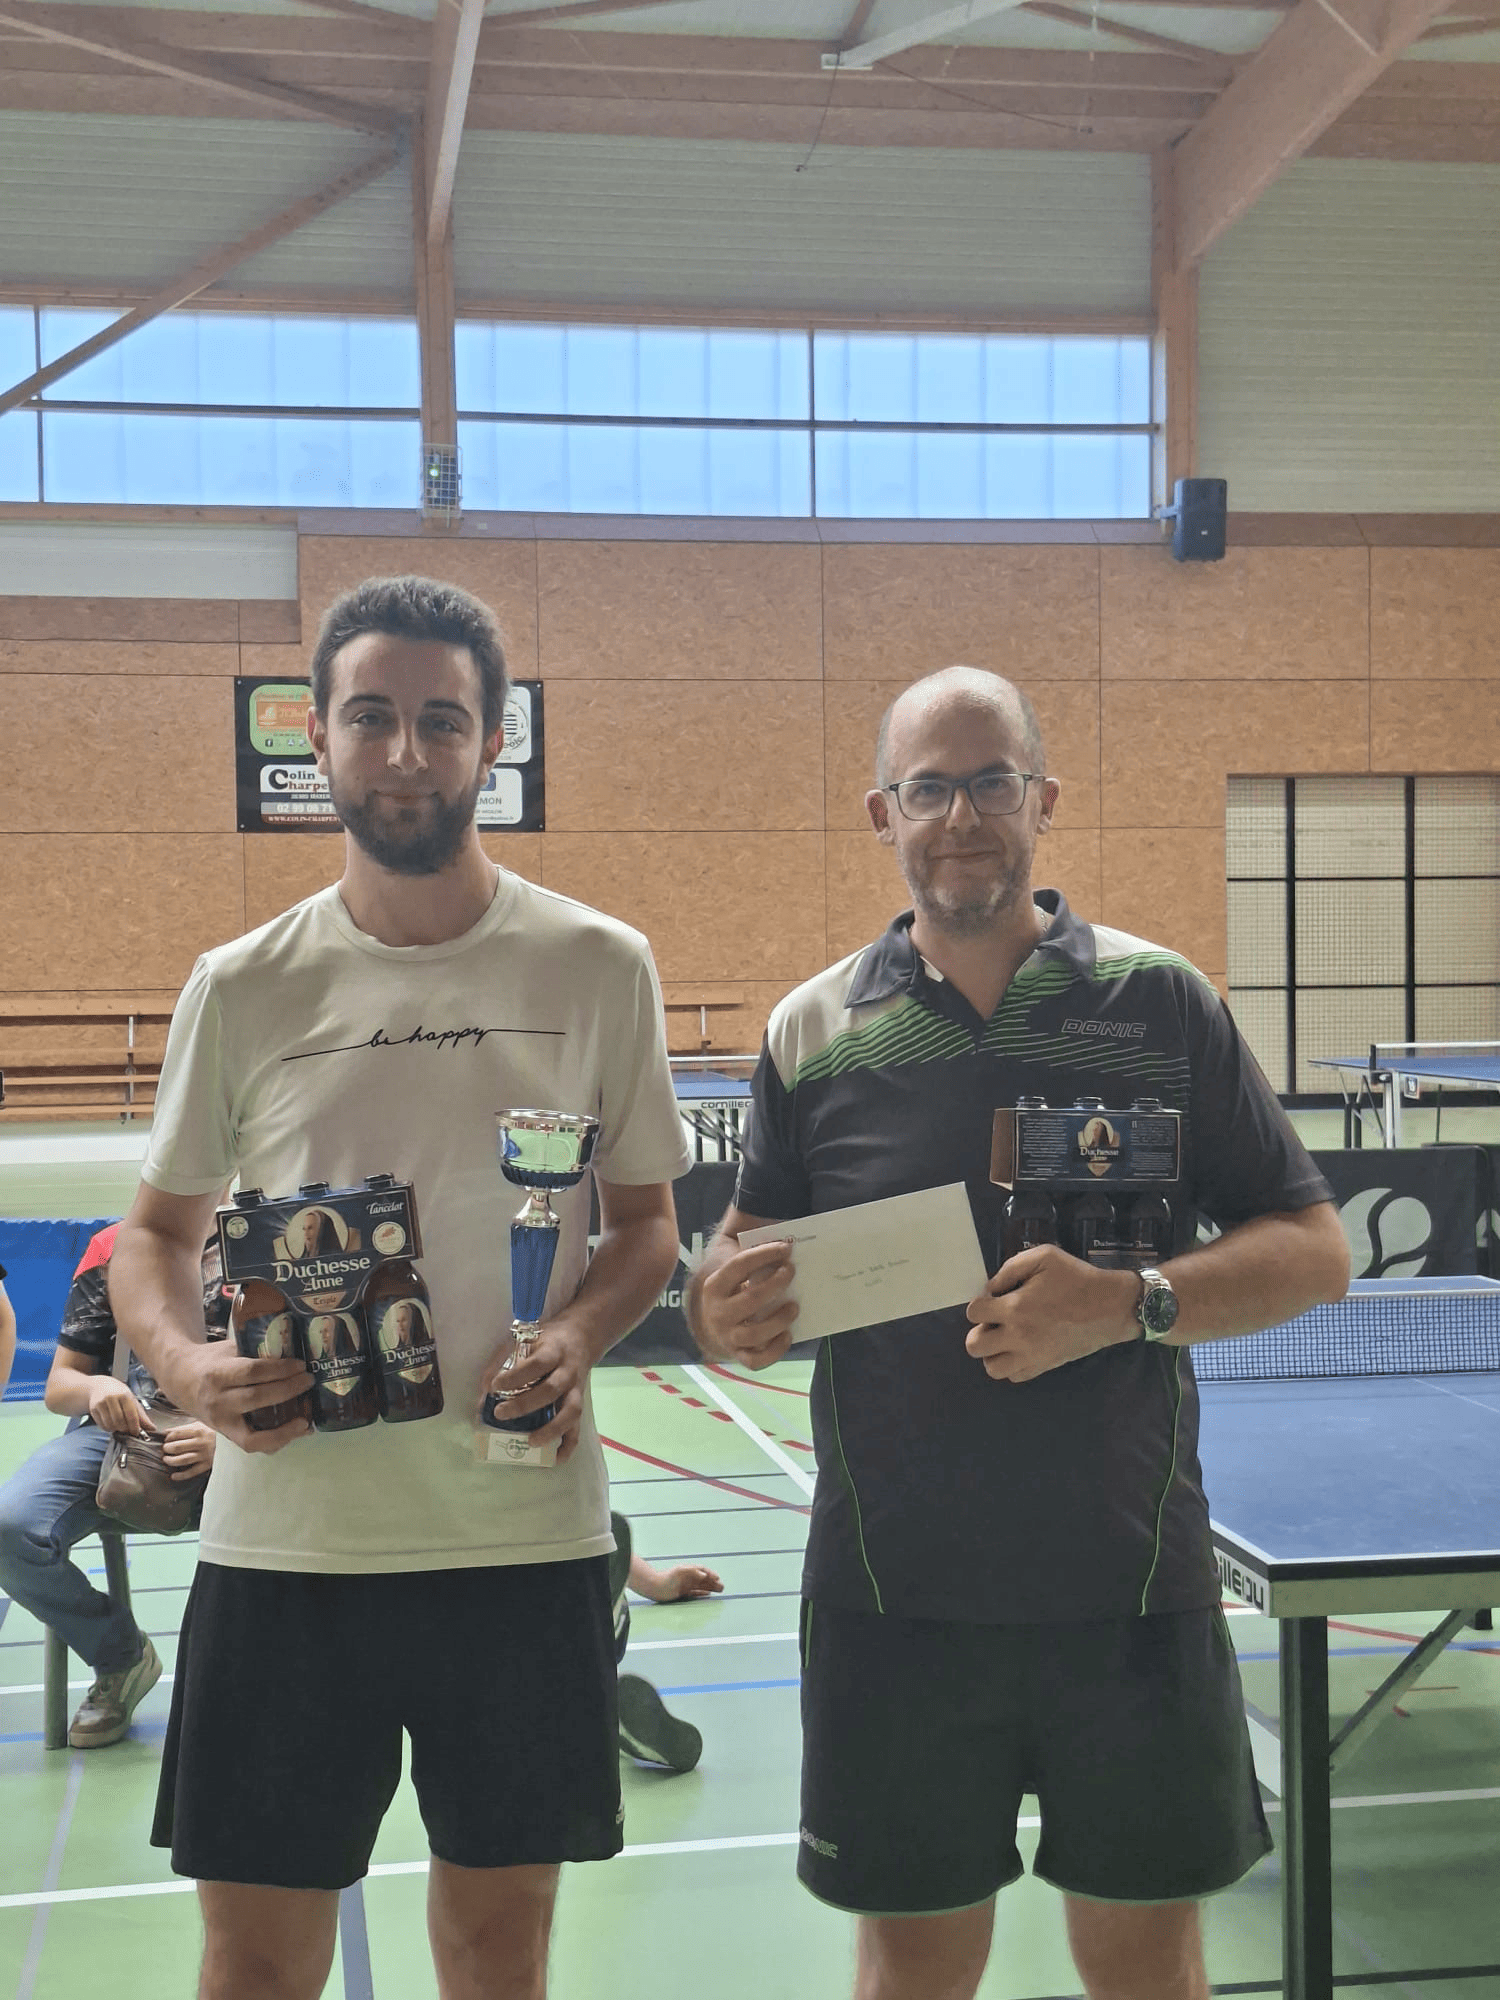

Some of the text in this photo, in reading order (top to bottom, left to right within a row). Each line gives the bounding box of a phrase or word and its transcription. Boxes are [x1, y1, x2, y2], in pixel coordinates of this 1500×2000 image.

[477, 797, 502, 805] MON
[370, 1025, 489, 1050] be happy
[1061, 1018, 1147, 1038] DONIC
[271, 1257, 371, 1282] Duchesse
[301, 1275, 344, 1292] Anne
